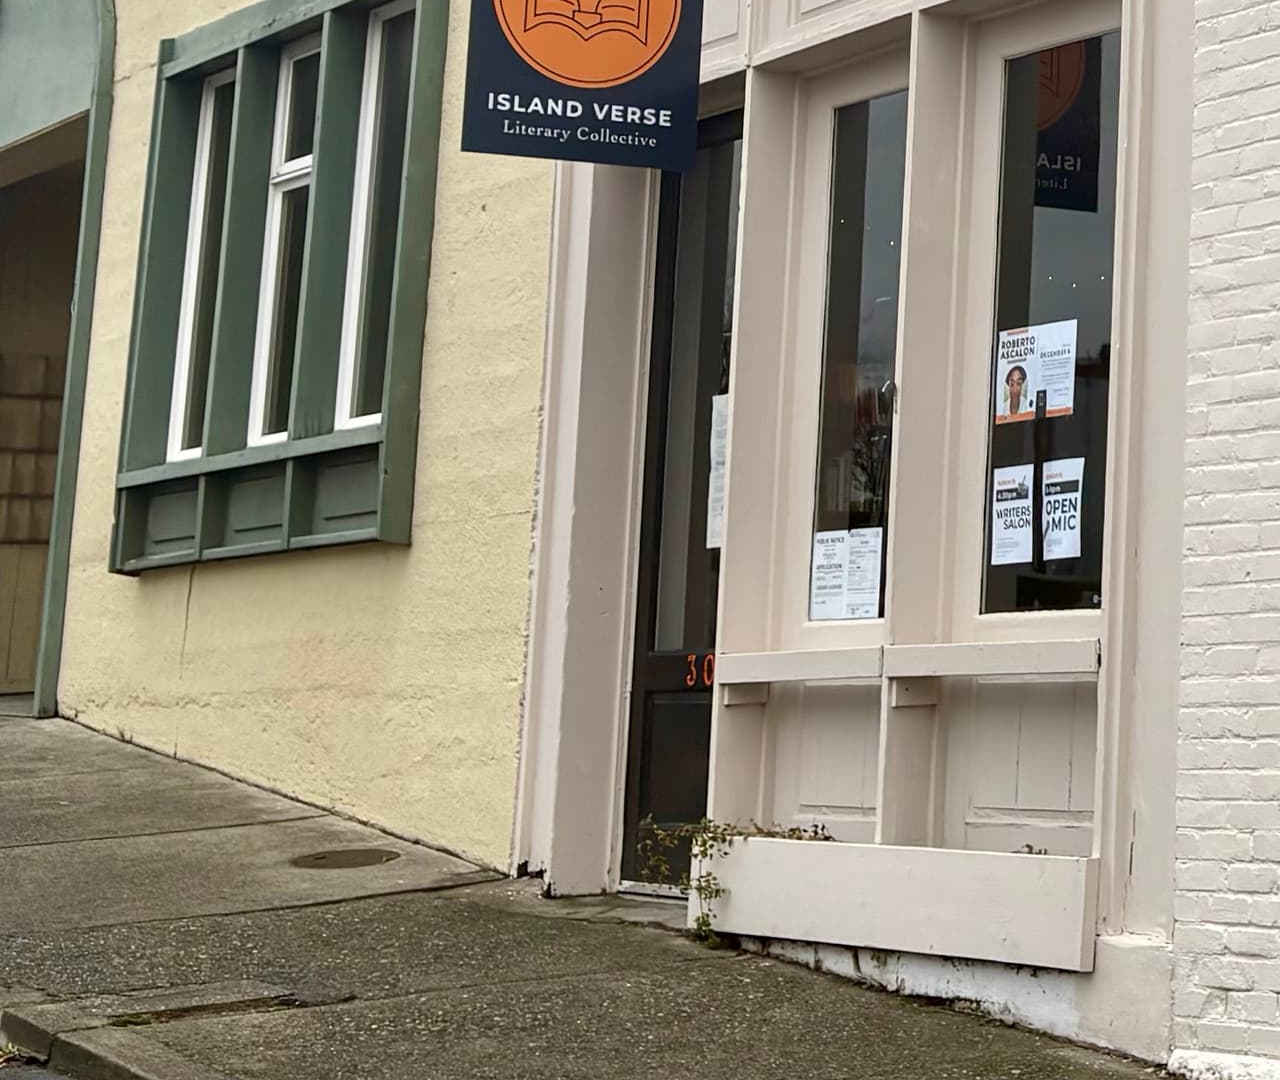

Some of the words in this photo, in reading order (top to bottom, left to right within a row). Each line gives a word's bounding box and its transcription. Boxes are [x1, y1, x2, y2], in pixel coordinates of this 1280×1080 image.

[487, 91, 584, 119] ISLAND
[593, 102, 673, 127] VERSE
[503, 119, 571, 143] Literary
[577, 126, 657, 148] Collective
[1000, 336, 1036, 350] ROBERTO
[1000, 346, 1036, 361] ASCALON
[996, 505, 1031, 519] WRITERS
[1046, 497, 1078, 516] OPEN
[1003, 517, 1031, 530] SALON
[1051, 515, 1077, 532] MIC
[686, 653, 715, 687] 30
